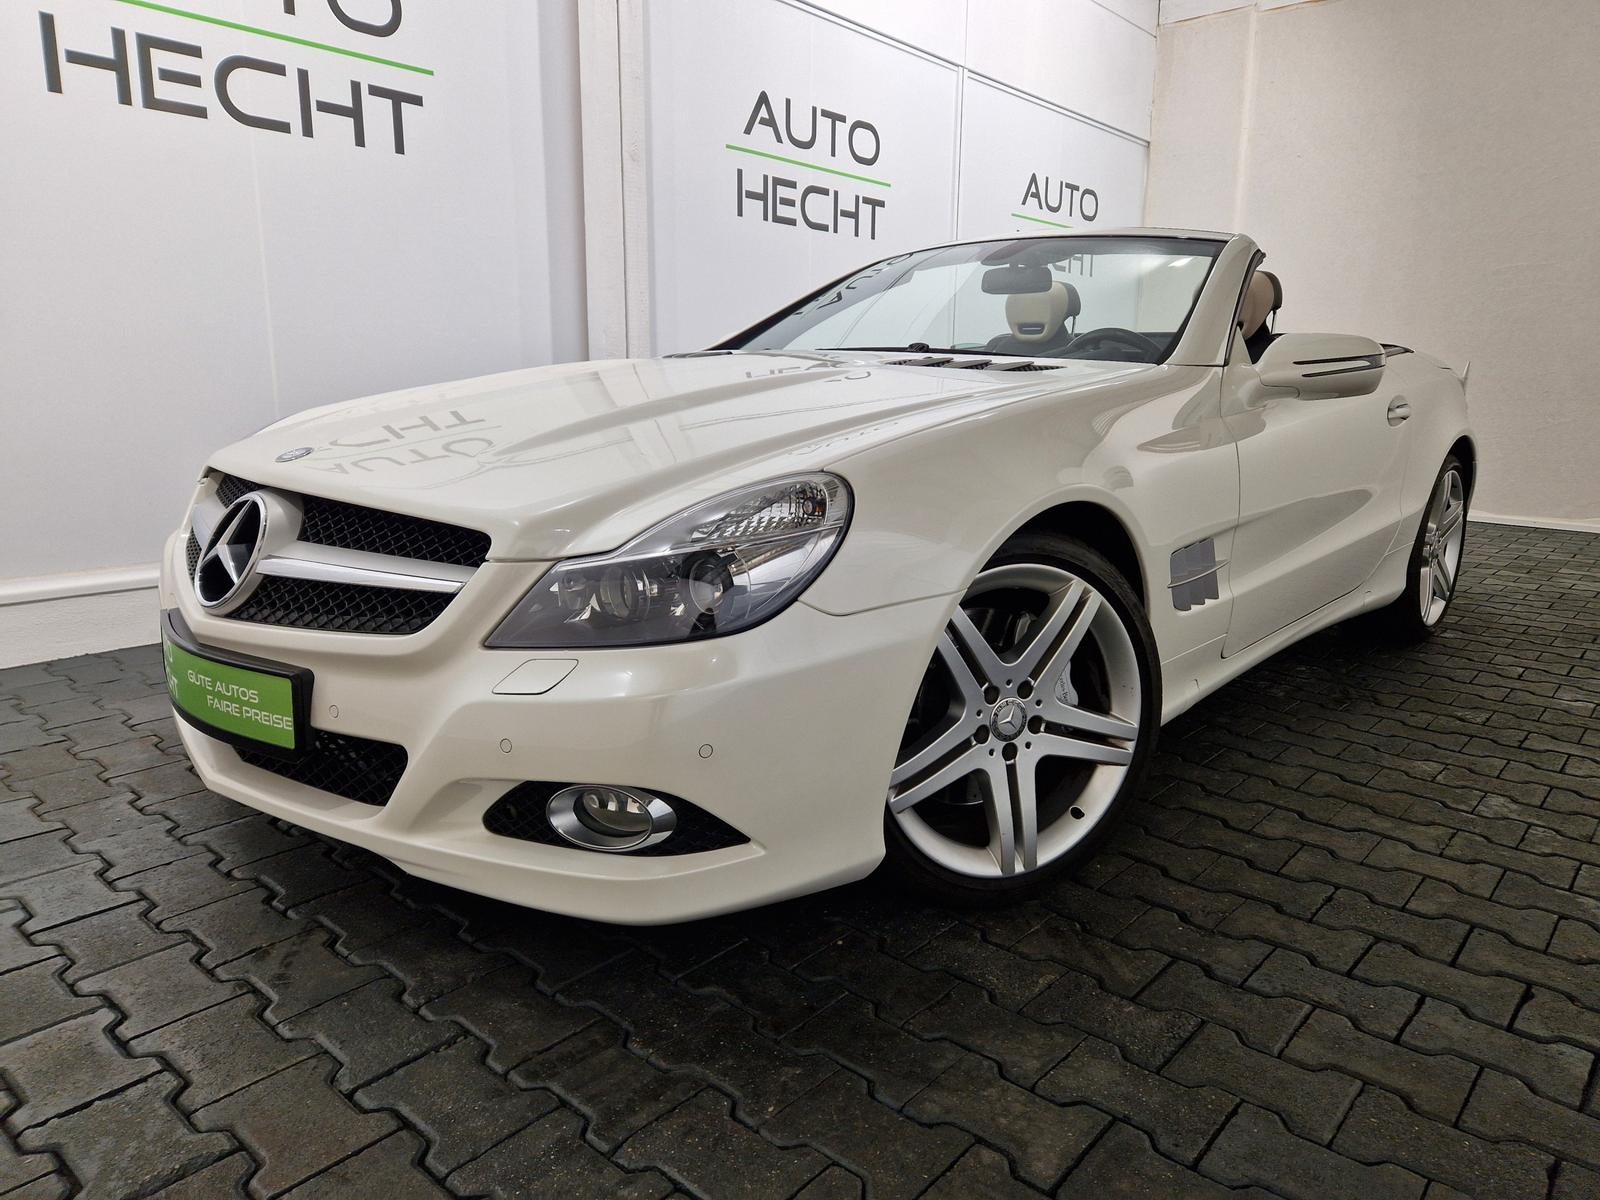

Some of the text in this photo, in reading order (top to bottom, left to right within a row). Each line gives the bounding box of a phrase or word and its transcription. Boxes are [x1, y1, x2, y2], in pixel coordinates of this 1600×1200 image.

[38, 10, 424, 155] HECHT
[743, 90, 881, 166] AUTO
[736, 168, 886, 240] HECHT
[1021, 172, 1099, 222] AUTO
[187, 670, 213, 691] GUTE
[215, 681, 259, 704] AUTOS
[206, 695, 293, 730] FAIRE PREISE
